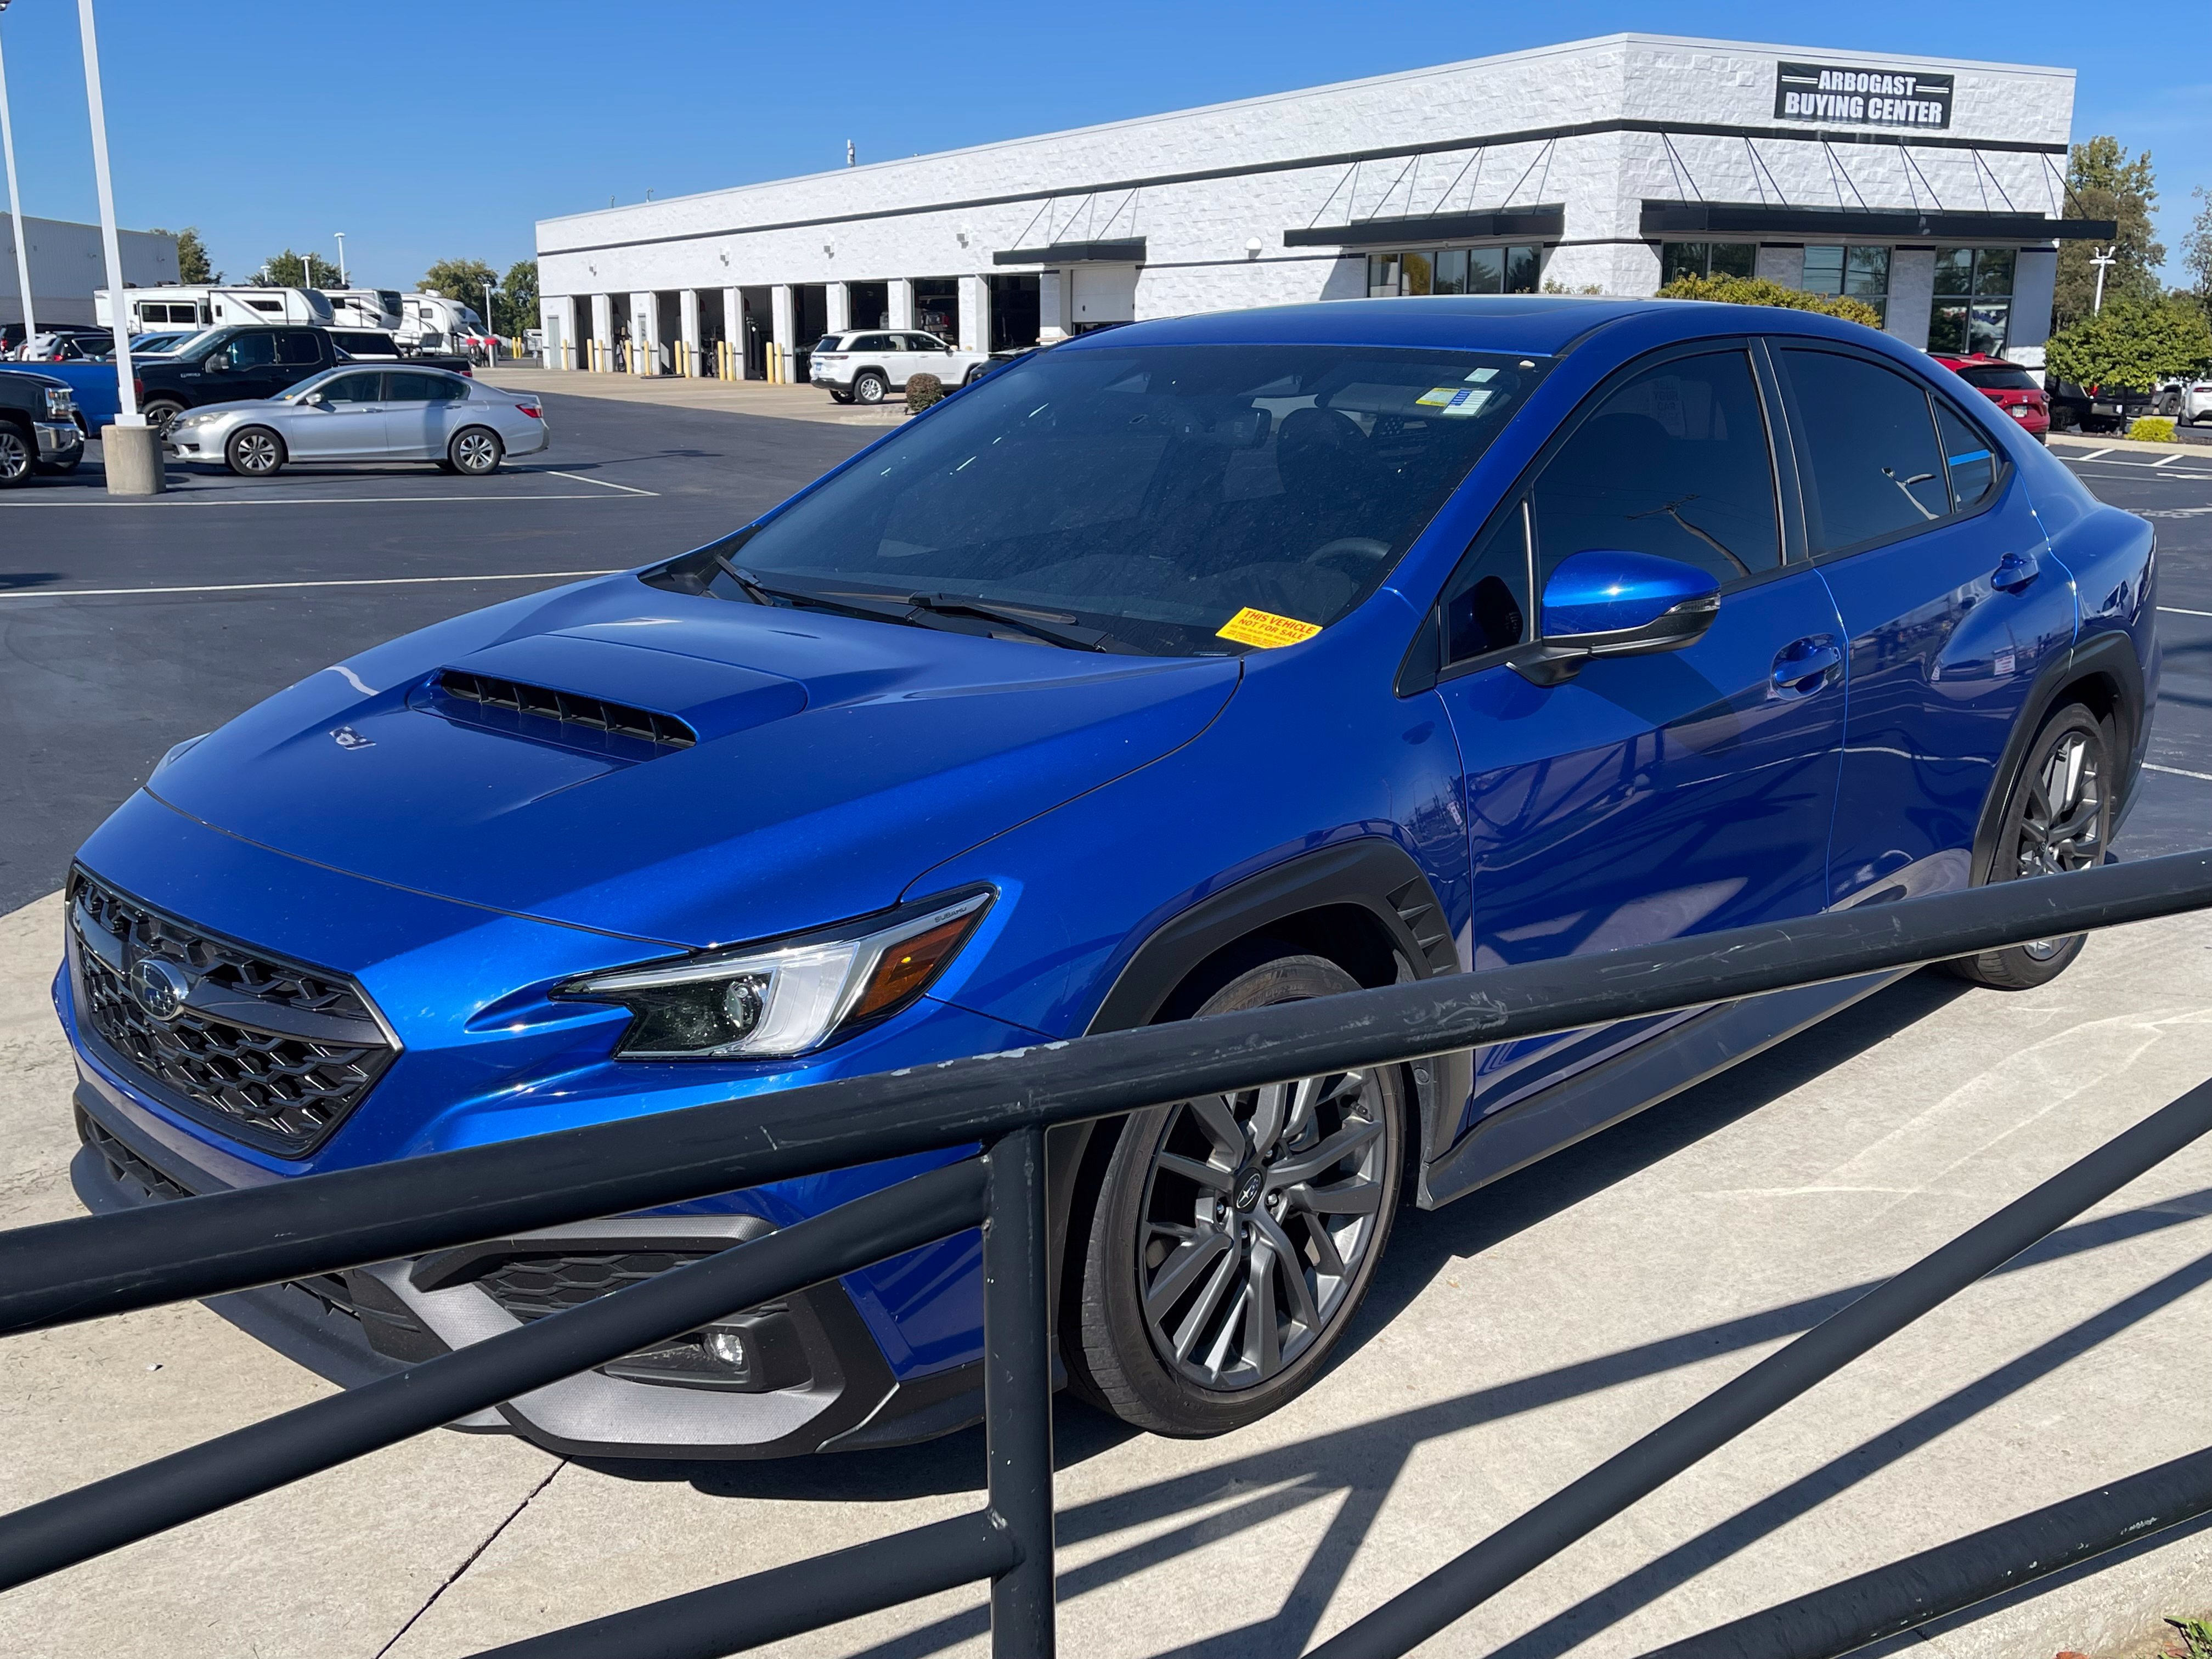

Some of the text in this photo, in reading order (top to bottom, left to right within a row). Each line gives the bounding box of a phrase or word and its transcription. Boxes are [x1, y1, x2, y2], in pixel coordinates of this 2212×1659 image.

[1818, 70, 1916, 96] ARBOGAST
[1784, 92, 1942, 123] BUYING CENTER
[1238, 618, 1259, 629] NOT
[1259, 624, 1279, 633] FOR
[1280, 630, 1306, 640] SALE
[1244, 610, 1269, 622] THIS
[1269, 616, 1316, 634] VEHICLE
[934, 906, 967, 923] SUBARU
